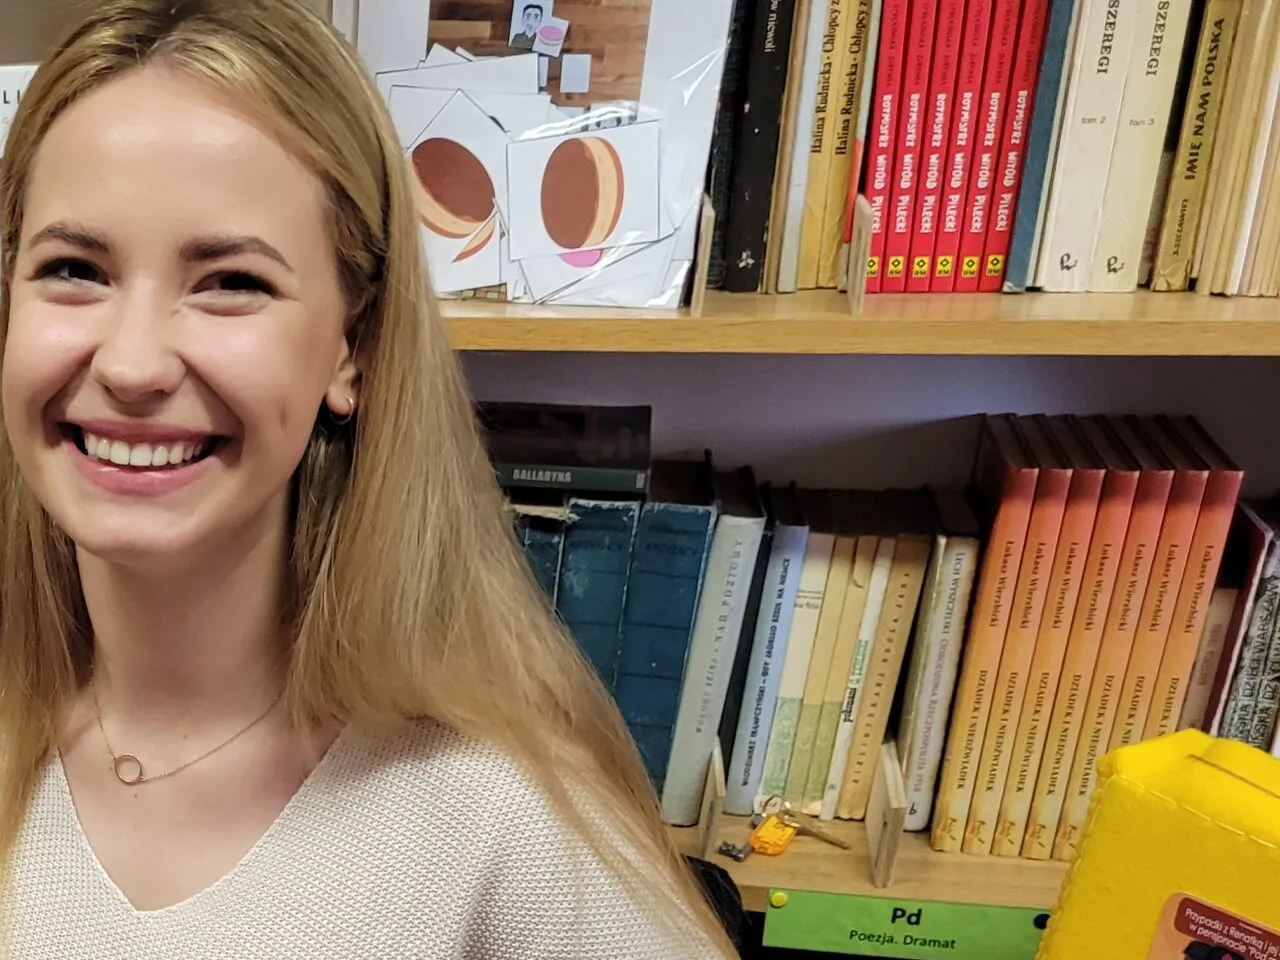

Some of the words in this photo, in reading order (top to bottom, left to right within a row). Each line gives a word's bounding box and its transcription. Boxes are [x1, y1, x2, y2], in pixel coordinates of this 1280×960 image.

[764, 13, 779, 53] niewoli
[822, 8, 842, 54] Chłopcy
[847, 8, 868, 54] Chłopcy
[1096, 0, 1119, 75] SZEREGI
[1145, 0, 1170, 77] SZEREGI
[1201, 18, 1225, 87] POLSKA
[815, 61, 833, 114] Rudnicka
[840, 62, 858, 116] Rudnicka
[810, 116, 826, 154] Halina
[835, 118, 851, 155] Halina
[879, 94, 893, 148] ROTMISTRZ
[905, 93, 920, 147] ROTMISTRZ
[931, 93, 947, 147] ROTMISTRZ
[1099, 116, 1106, 124] 2
[1192, 91, 1211, 136] NAM
[873, 153, 888, 190] WITOLD
[900, 153, 915, 189] WITOLD
[925, 153, 940, 189] WITOLD
[950, 152, 965, 188] WITOLD
[999, 540, 1015, 577] Łukasz
[1030, 541, 1047, 578] Łukasz
[1063, 541, 1079, 578] Łukasz
[1097, 542, 1112, 580] Łukasz
[990, 578, 1008, 628] Wierzbicki
[1020, 580, 1039, 630] Wierzbicki
[1051, 580, 1071, 630] Wierzbicki
[1084, 581, 1104, 632] Wierzbicki
[972, 669, 988, 716] DZIADEK
[1002, 671, 1018, 718] DZIADEK
[1033, 671, 1050, 719] DZIADEK
[1065, 673, 1082, 722] DZIADEK
[955, 726, 975, 791] NIEDŹWIADEK
[985, 728, 1006, 793] NIEDŹWIADEK
[1015, 729, 1037, 794] NIEDŹWIADEK
[1046, 731, 1067, 796] NIEDŹWIADEK
[848, 929, 898, 947] Poezja.
[903, 933, 957, 951] Dramat
[890, 907, 922, 926] Pd
[1184, 908, 1224, 933] Przypadki
[1196, 925, 1247, 954] pensjonacie
